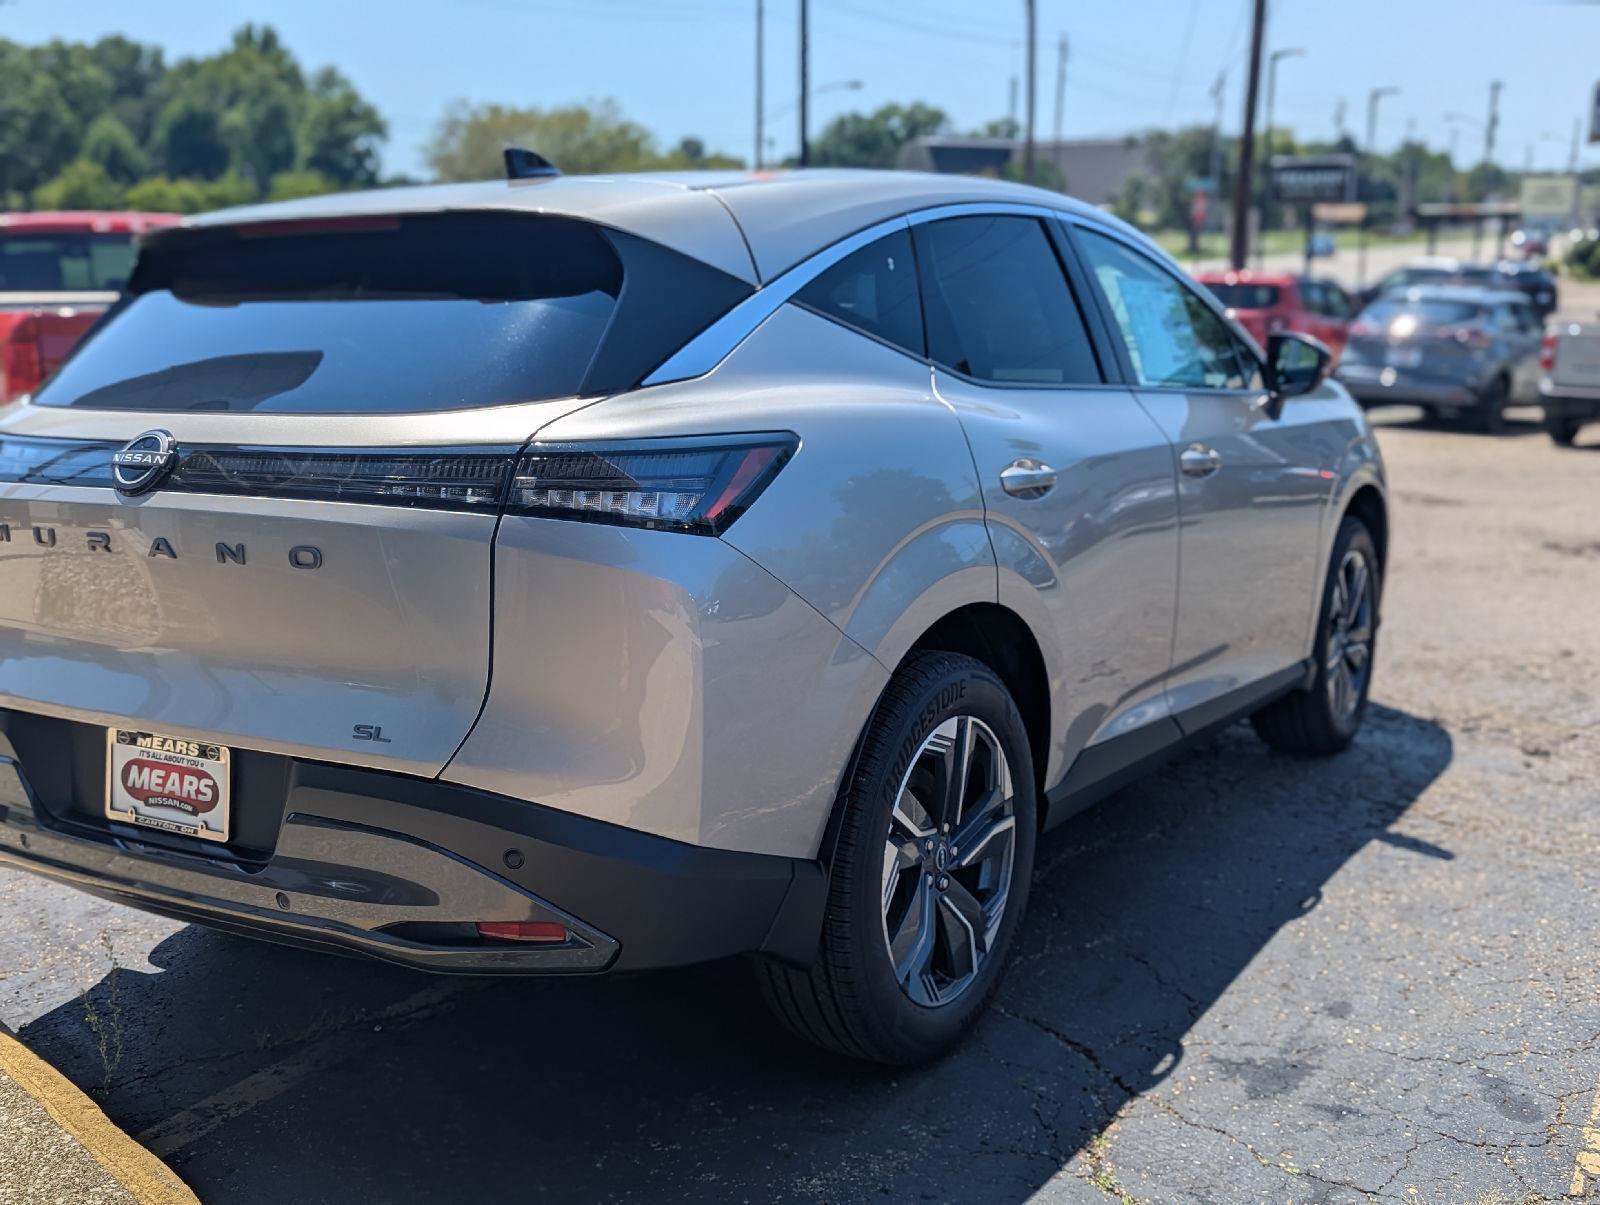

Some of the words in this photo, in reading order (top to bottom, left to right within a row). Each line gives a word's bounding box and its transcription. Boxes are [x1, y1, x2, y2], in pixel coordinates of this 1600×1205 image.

[112, 453, 167, 464] NISSAN
[352, 724, 391, 743] SL
[136, 737, 200, 757] MEARS
[151, 752, 162, 760] ALL
[163, 754, 186, 764] ABOUT
[186, 759, 200, 767] YOU
[127, 765, 214, 802] MEARS
[180, 826, 194, 834] OH
